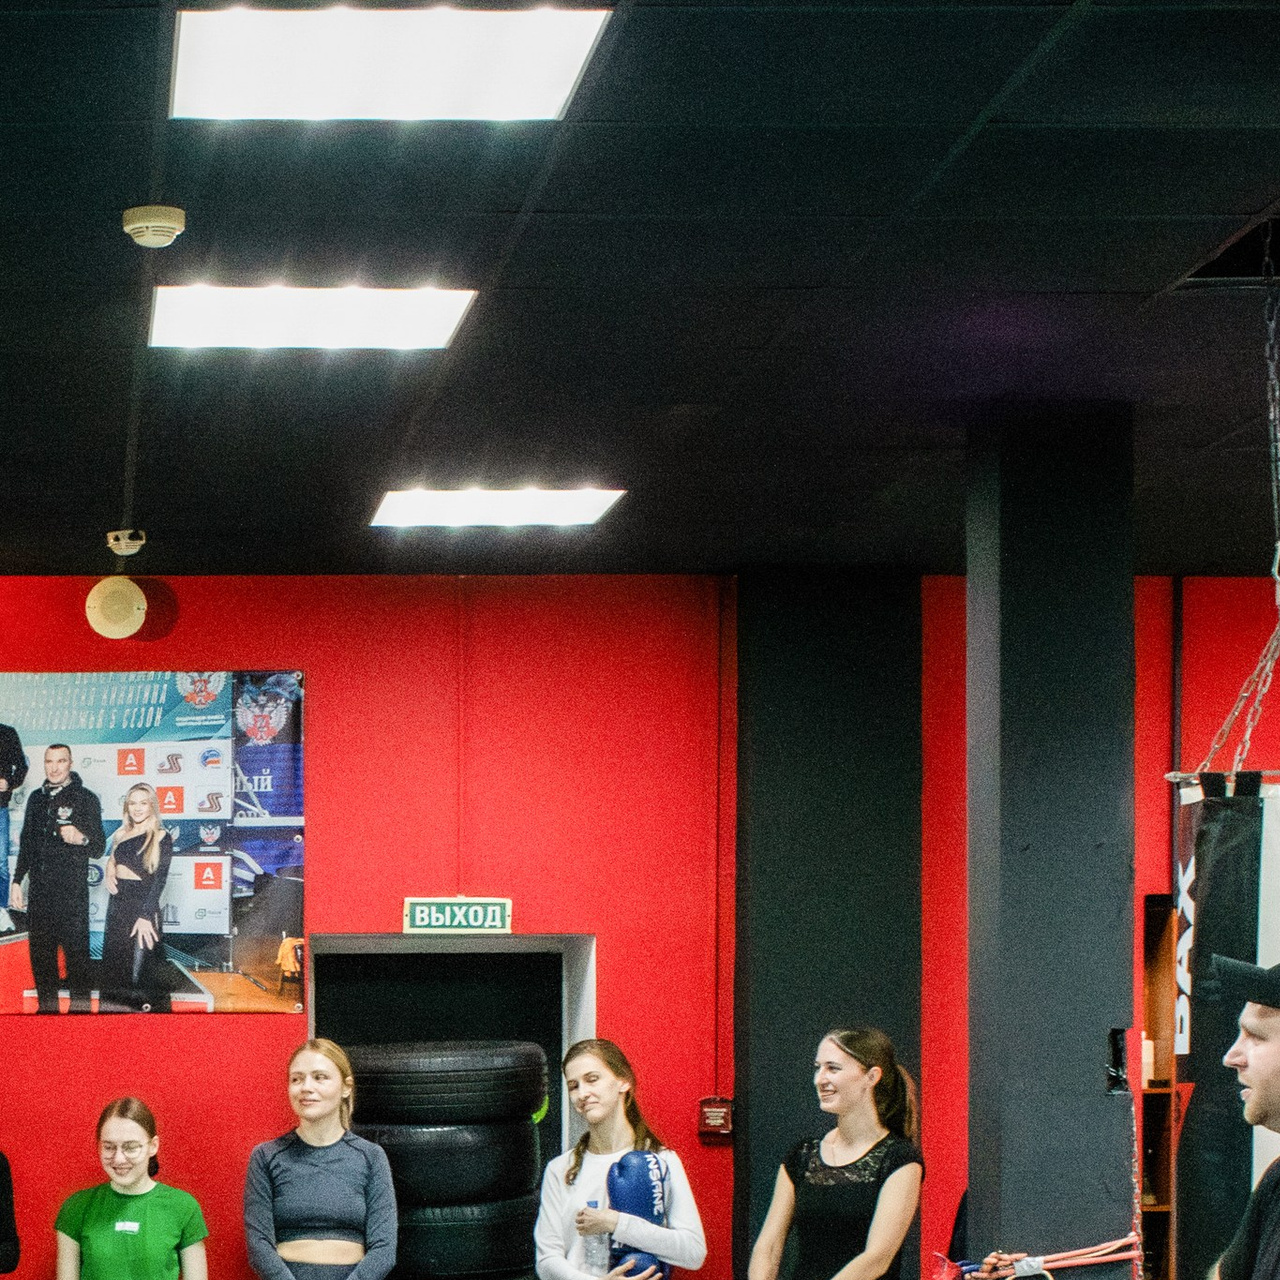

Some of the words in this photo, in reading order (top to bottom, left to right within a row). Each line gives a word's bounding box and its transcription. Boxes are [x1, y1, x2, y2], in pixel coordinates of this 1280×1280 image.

[122, 706, 164, 729] СЕЗОН
[414, 905, 503, 928] ВЫХОД
[645, 1154, 664, 1216] INSANE
